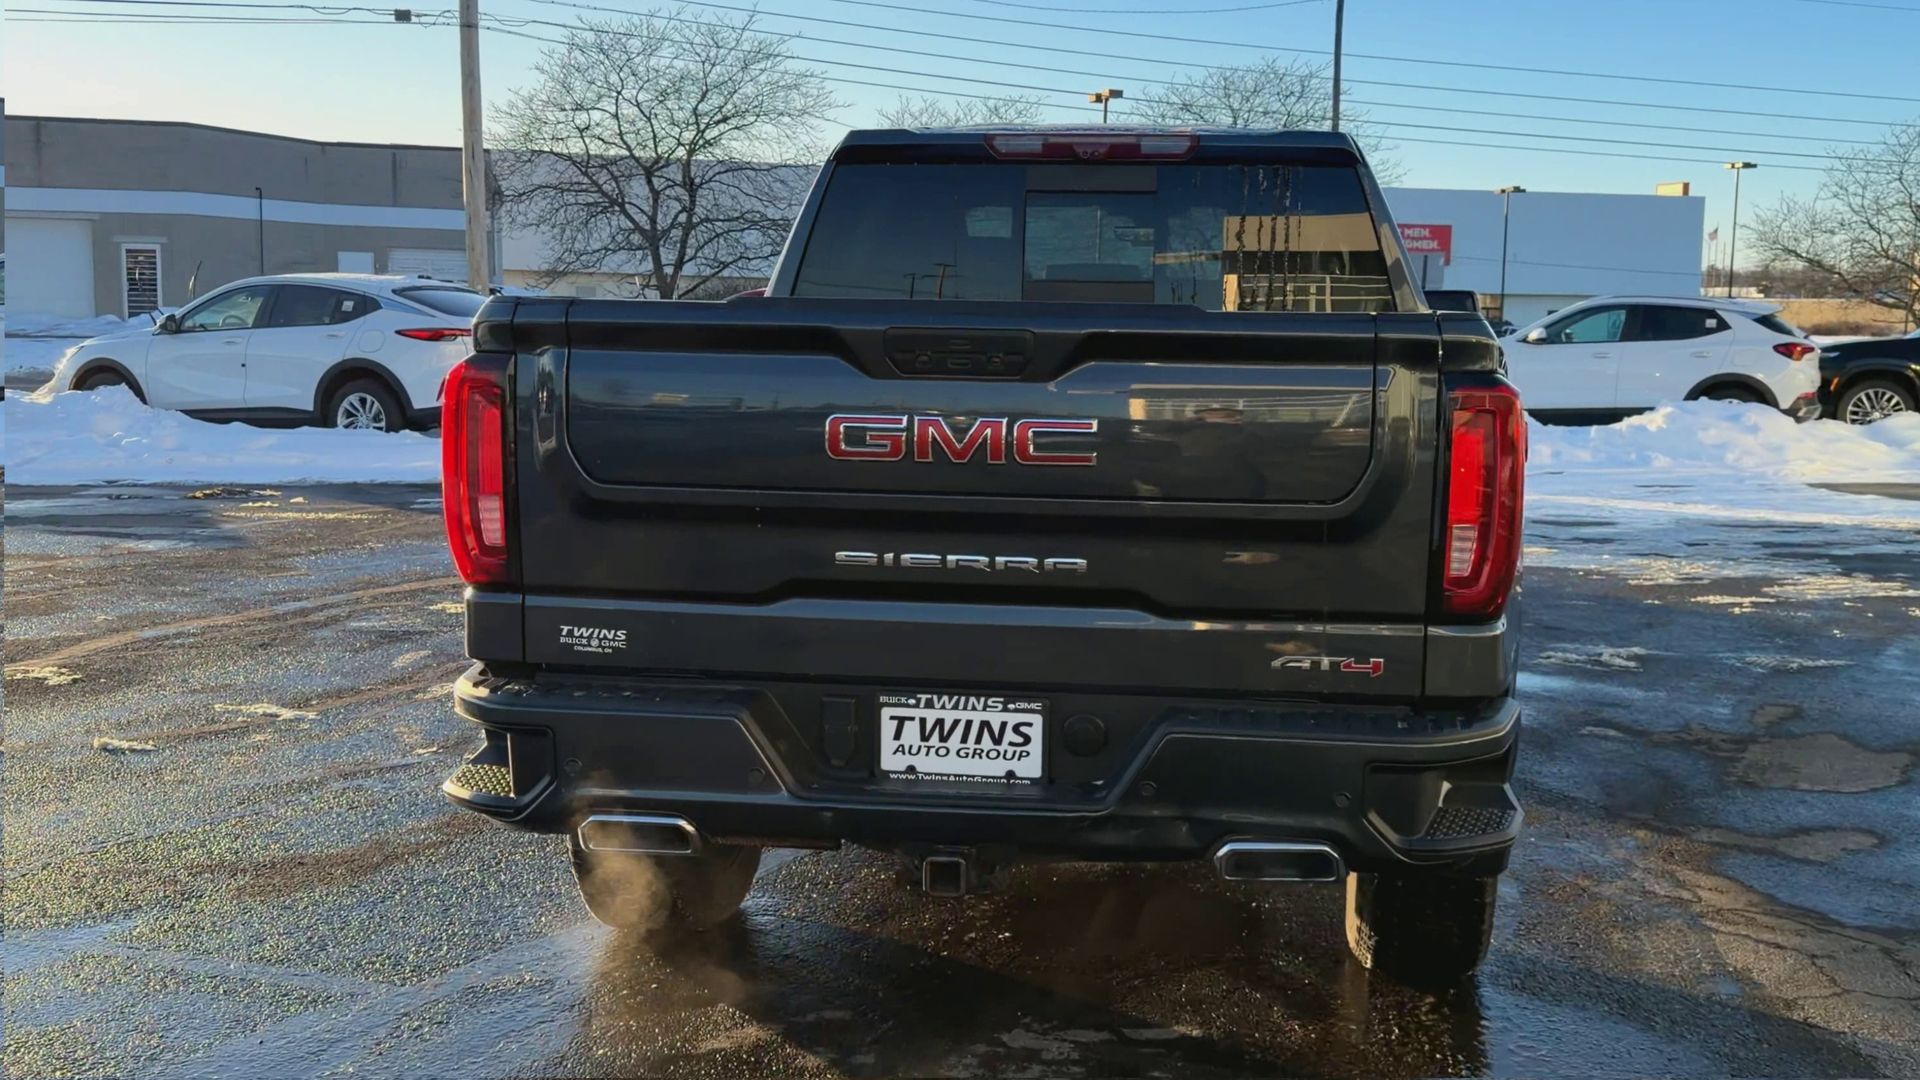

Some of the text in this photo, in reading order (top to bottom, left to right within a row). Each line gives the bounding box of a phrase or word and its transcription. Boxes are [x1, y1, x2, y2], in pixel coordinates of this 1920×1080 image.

[825, 414, 1098, 466] GMC
[834, 551, 1088, 573] SIERRA
[560, 625, 627, 640] TWINS
[560, 636, 627, 648] BUICK GMC
[1270, 655, 1384, 677] AT4
[879, 694, 1042, 711] BUICK TWINS GMC
[889, 715, 1034, 747] TWINS
[892, 744, 1031, 761] AUTO GROUP
[889, 772, 1031, 784] www.TwinsAutoGroupcom
